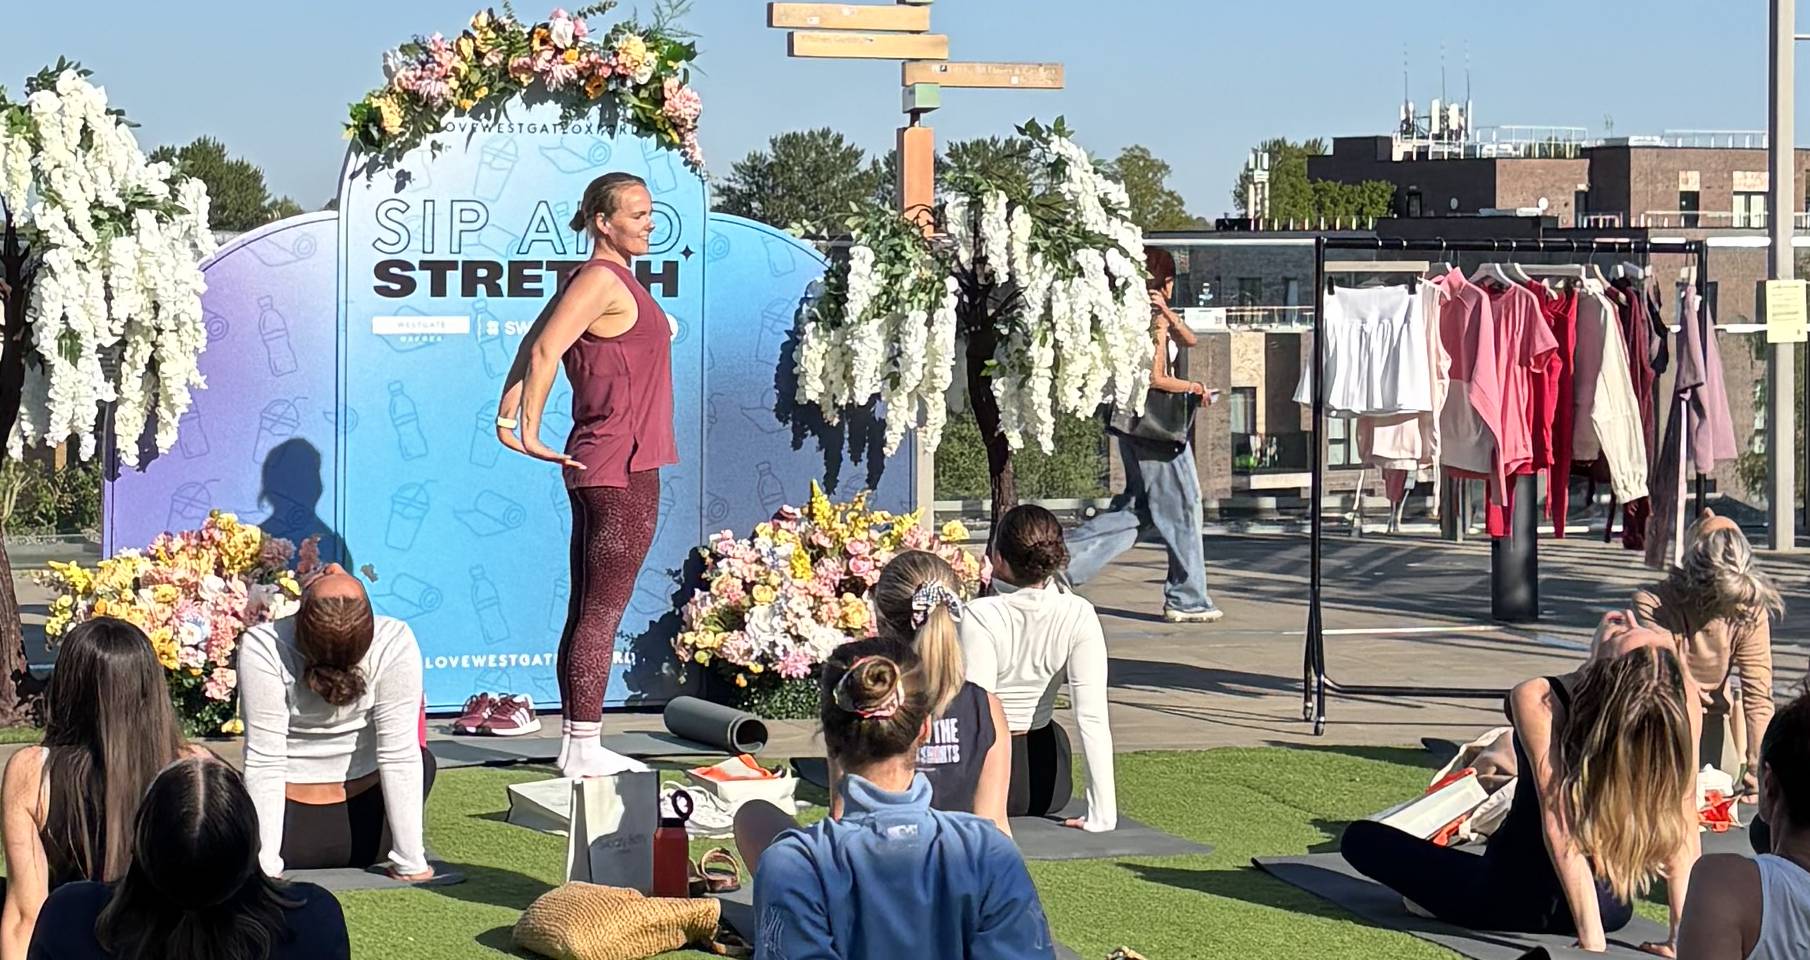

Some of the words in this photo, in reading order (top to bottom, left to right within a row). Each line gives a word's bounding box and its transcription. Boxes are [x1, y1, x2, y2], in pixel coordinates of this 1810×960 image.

[372, 198, 489, 255] SIP
[372, 259, 679, 298] STRETH
[932, 717, 959, 744] THE
